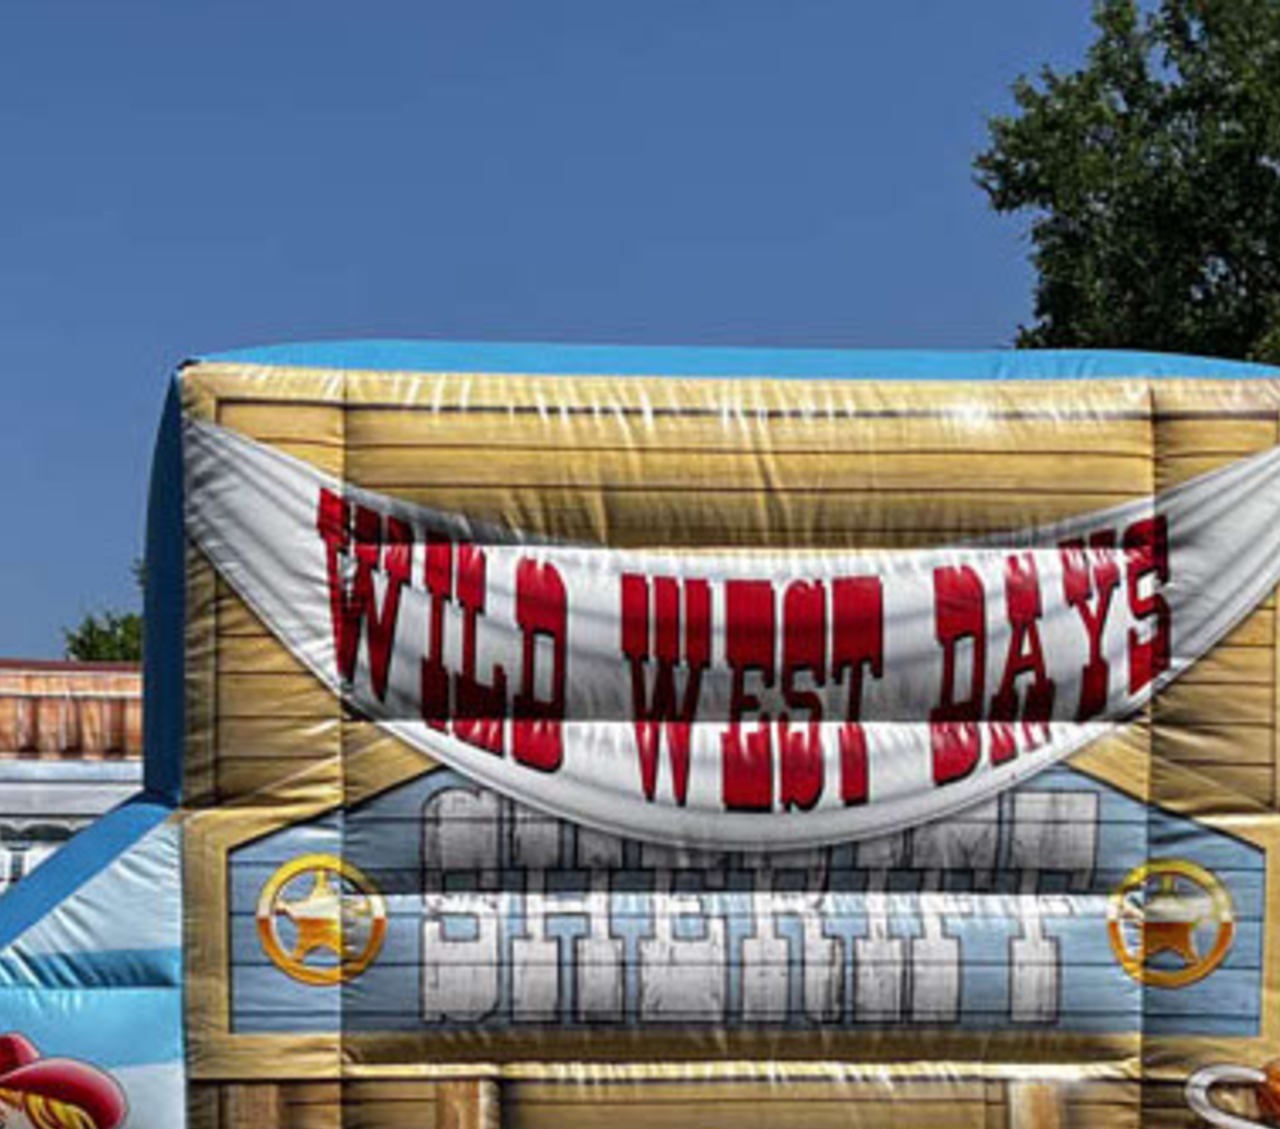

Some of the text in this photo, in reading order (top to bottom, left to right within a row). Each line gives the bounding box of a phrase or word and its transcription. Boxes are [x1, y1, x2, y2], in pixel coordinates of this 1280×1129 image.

[318, 486, 1173, 814] WILD WEST DAYS
[420, 788, 1100, 1024] SHERIFF
